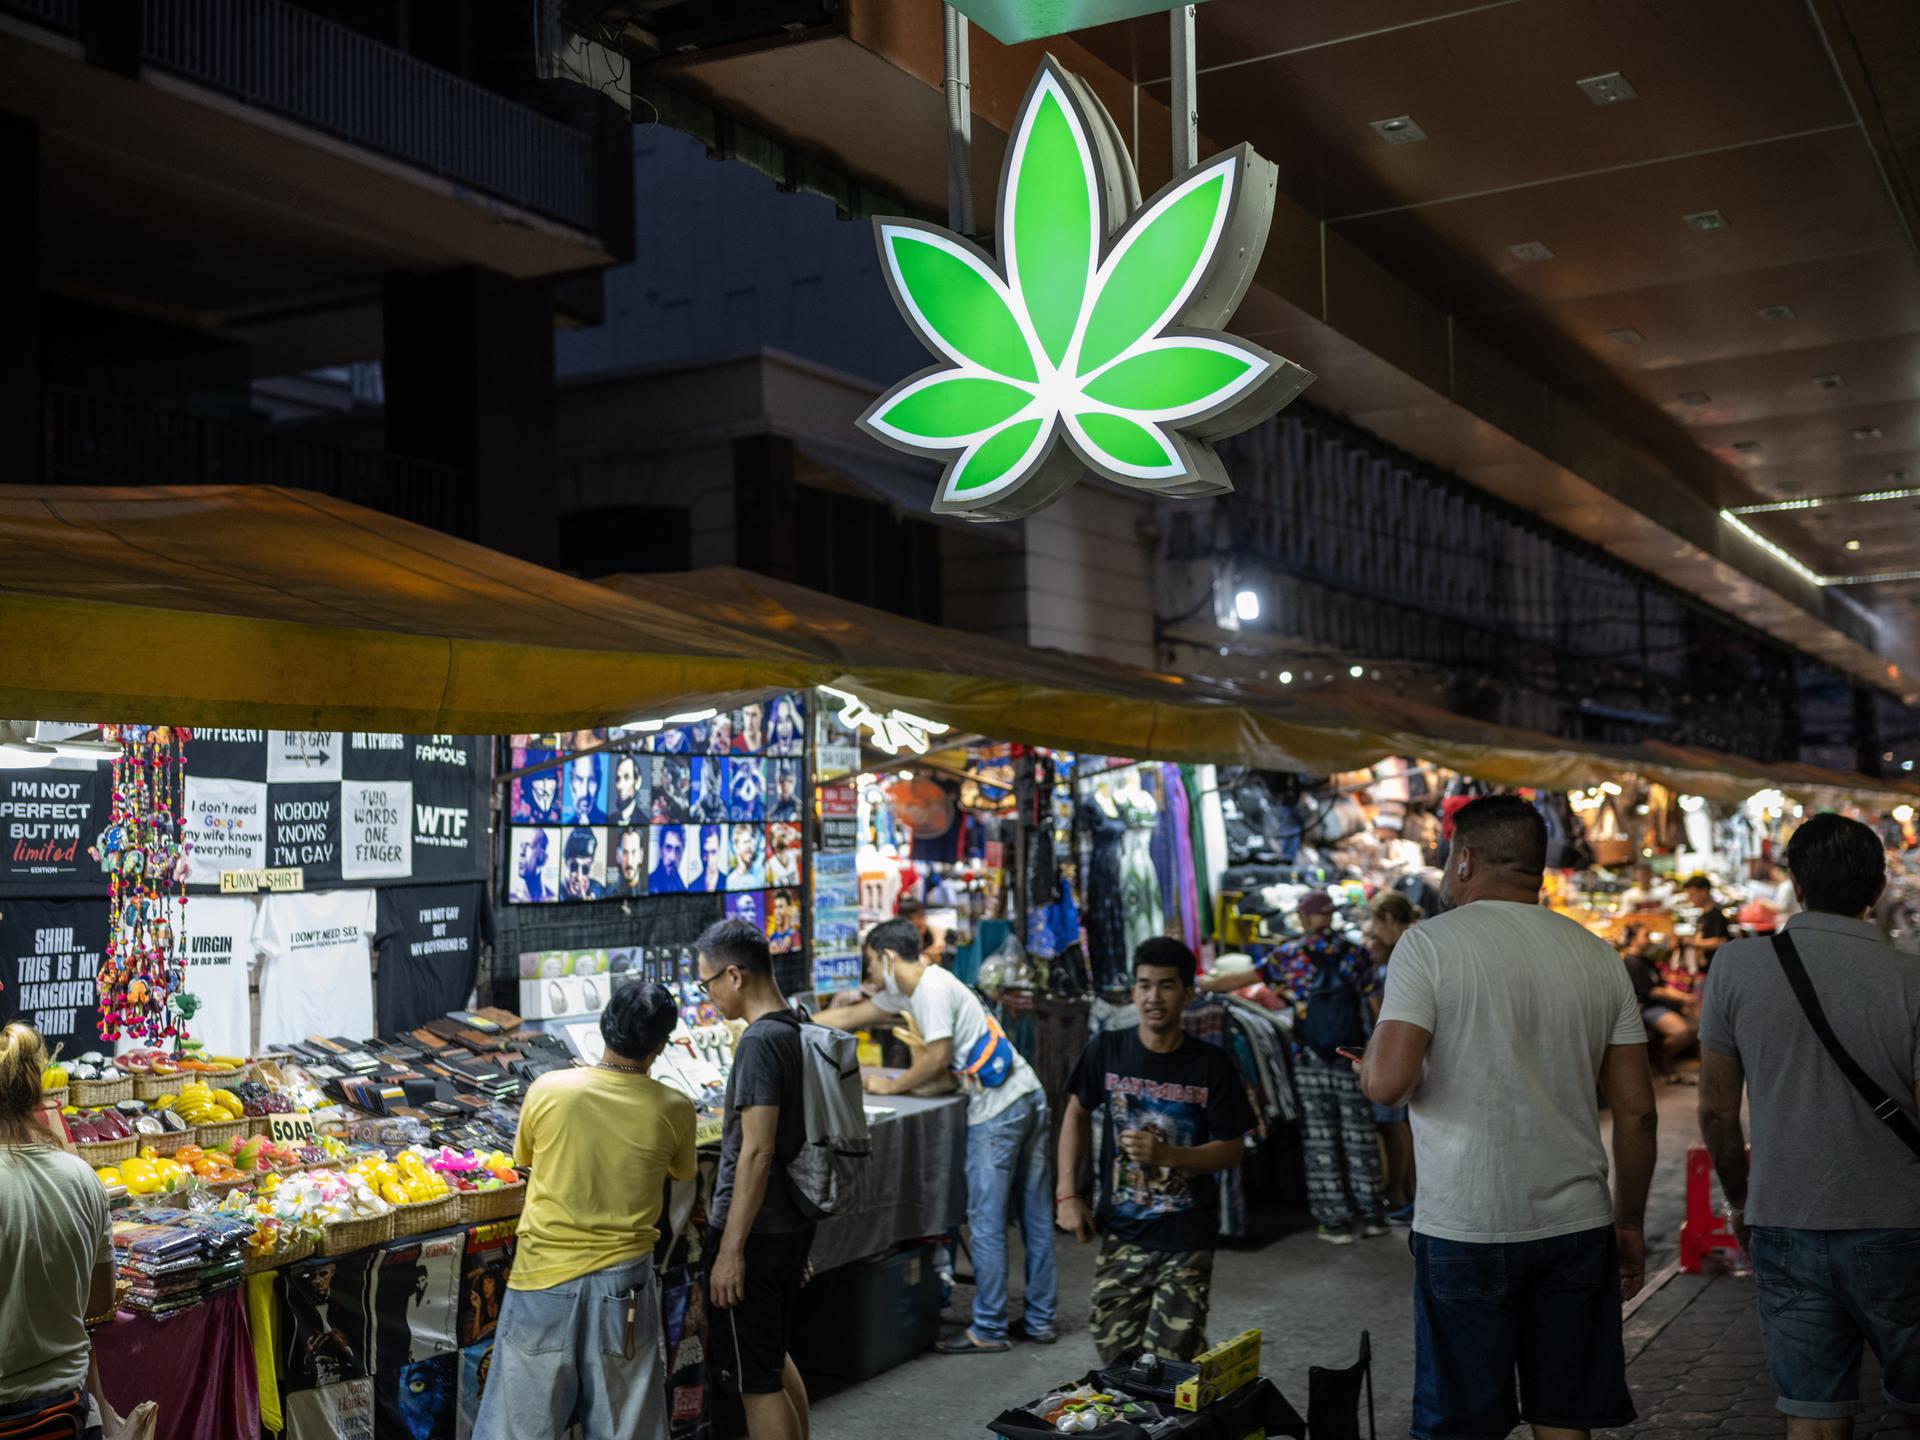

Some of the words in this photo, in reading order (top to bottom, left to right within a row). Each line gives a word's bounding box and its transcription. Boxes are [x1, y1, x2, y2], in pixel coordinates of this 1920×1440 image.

[193, 728, 263, 743] DIFFERENT
[309, 731, 331, 748] GAY
[416, 744, 467, 767] FAMOUS
[11, 781, 38, 798] I'M
[40, 782, 81, 799] NOT
[360, 789, 387, 806] TWO
[0, 802, 91, 819] PERFECT
[199, 801, 229, 813] don't
[231, 803, 257, 815] need
[274, 801, 330, 822] NOBODY
[354, 807, 398, 825] WORDS
[205, 815, 243, 830] Google
[416, 803, 469, 837] WTF
[10, 823, 51, 839] BUT
[53, 823, 80, 840] I'M
[184, 830, 200, 842] my
[203, 830, 225, 842] wife
[228, 830, 263, 842] knows
[278, 821, 327, 844] KNOWS
[365, 827, 389, 844] ONE
[12, 838, 78, 862] limited
[194, 844, 252, 859] everything
[273, 846, 298, 866] I'M
[301, 842, 334, 862] GAY
[356, 844, 402, 863] FINGER
[30, 866, 58, 874] EDITION
[223, 871, 260, 889] FUNNY
[266, 870, 300, 889] SHIRT
[34, 927, 86, 955] SHHH...
[295, 931, 320, 943] DON'T
[322, 928, 340, 940] NEED
[342, 926, 358, 938] SEX
[192, 936, 232, 953] VIRGIN
[18, 956, 51, 983] THIS
[57, 954, 72, 980] IS
[78, 953, 100, 979] MY
[19, 981, 94, 1011] HANGOVER
[34, 1008, 77, 1036] SHIRT
[273, 1120, 313, 1142] SOAP
